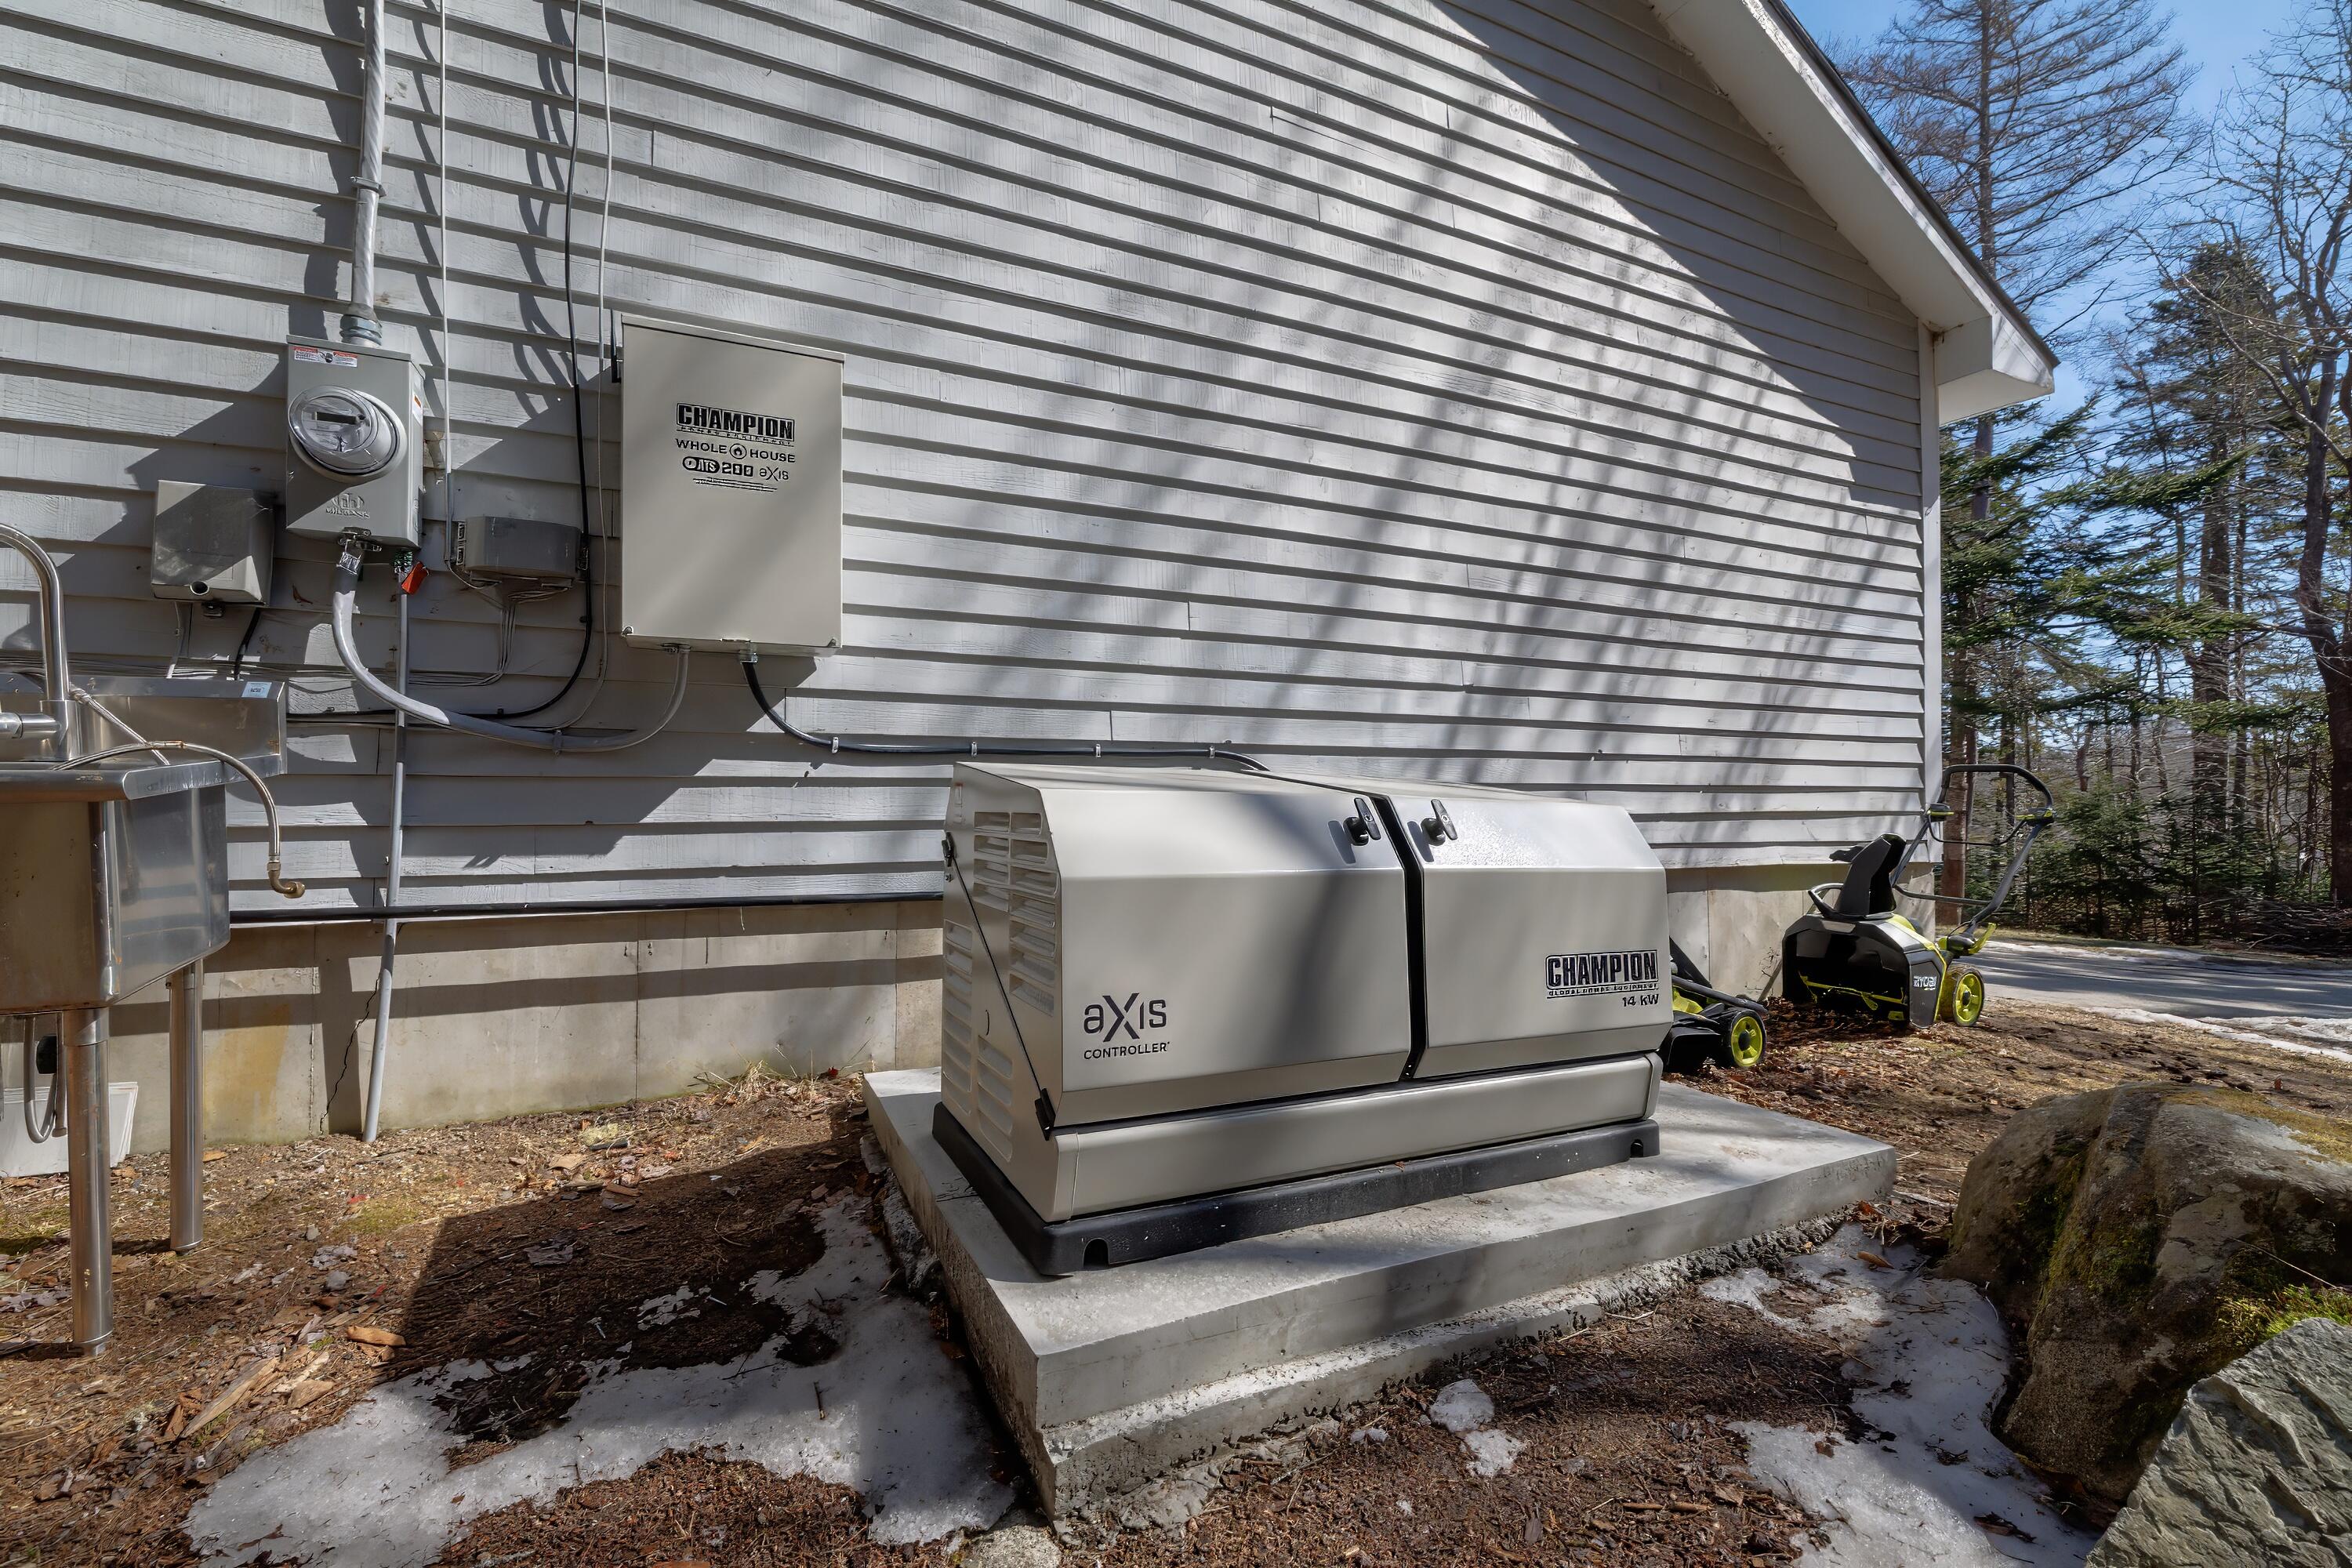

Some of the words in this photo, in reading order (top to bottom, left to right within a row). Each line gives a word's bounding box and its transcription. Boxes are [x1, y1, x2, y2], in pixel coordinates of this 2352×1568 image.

[678, 405, 793, 441] CHAMPION
[676, 438, 728, 454] WHOLE
[750, 448, 796, 463] HOUSE
[722, 462, 753, 477] 200
[1548, 952, 1657, 987] CHAMPION
[1622, 996, 1636, 1007] 14
[1083, 1042, 1168, 1059] CONTROLLER
